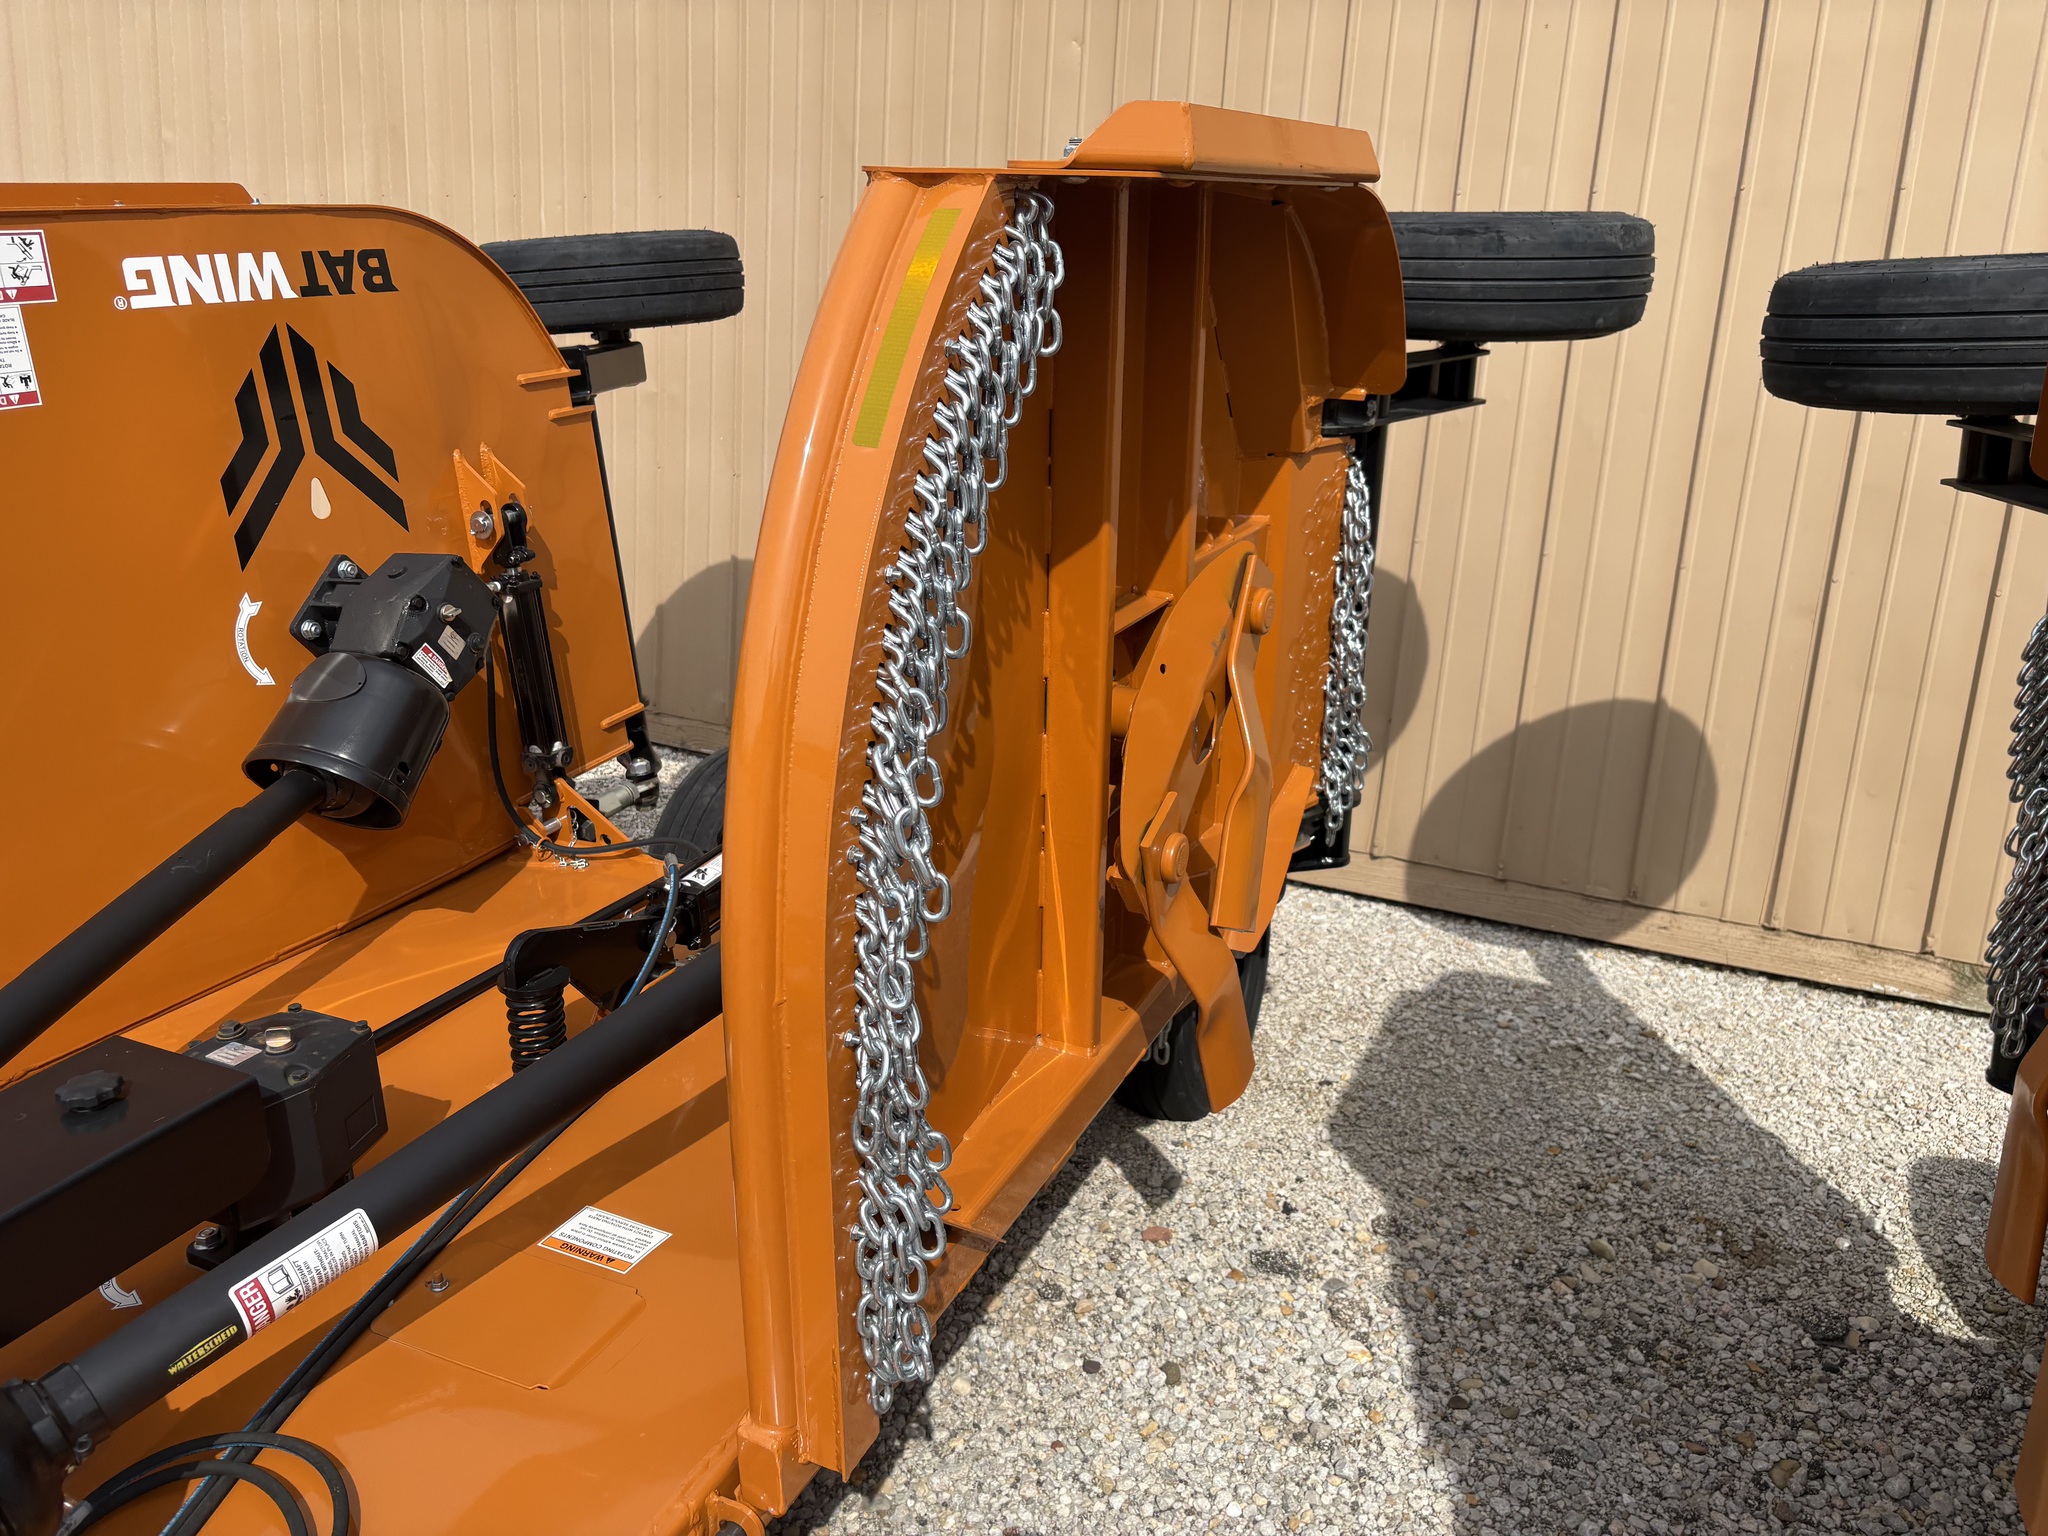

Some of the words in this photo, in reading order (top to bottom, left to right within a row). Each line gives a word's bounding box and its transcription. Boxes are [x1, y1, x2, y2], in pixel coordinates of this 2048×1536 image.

[237, 627, 250, 663] ROTATION
[339, 1231, 347, 1244] TURN
[352, 1220, 367, 1246] ADAPTORS
[557, 1232, 604, 1250] COMPONENTS
[316, 1239, 329, 1260] TRACTOR
[321, 1237, 331, 1251] PLACE
[559, 1242, 605, 1262] WARNING
[601, 1246, 636, 1260] ROTATING
[302, 1260, 312, 1275] DEATH
[313, 1265, 323, 1283] AWAY!
[239, 1282, 271, 1330] ANGER
